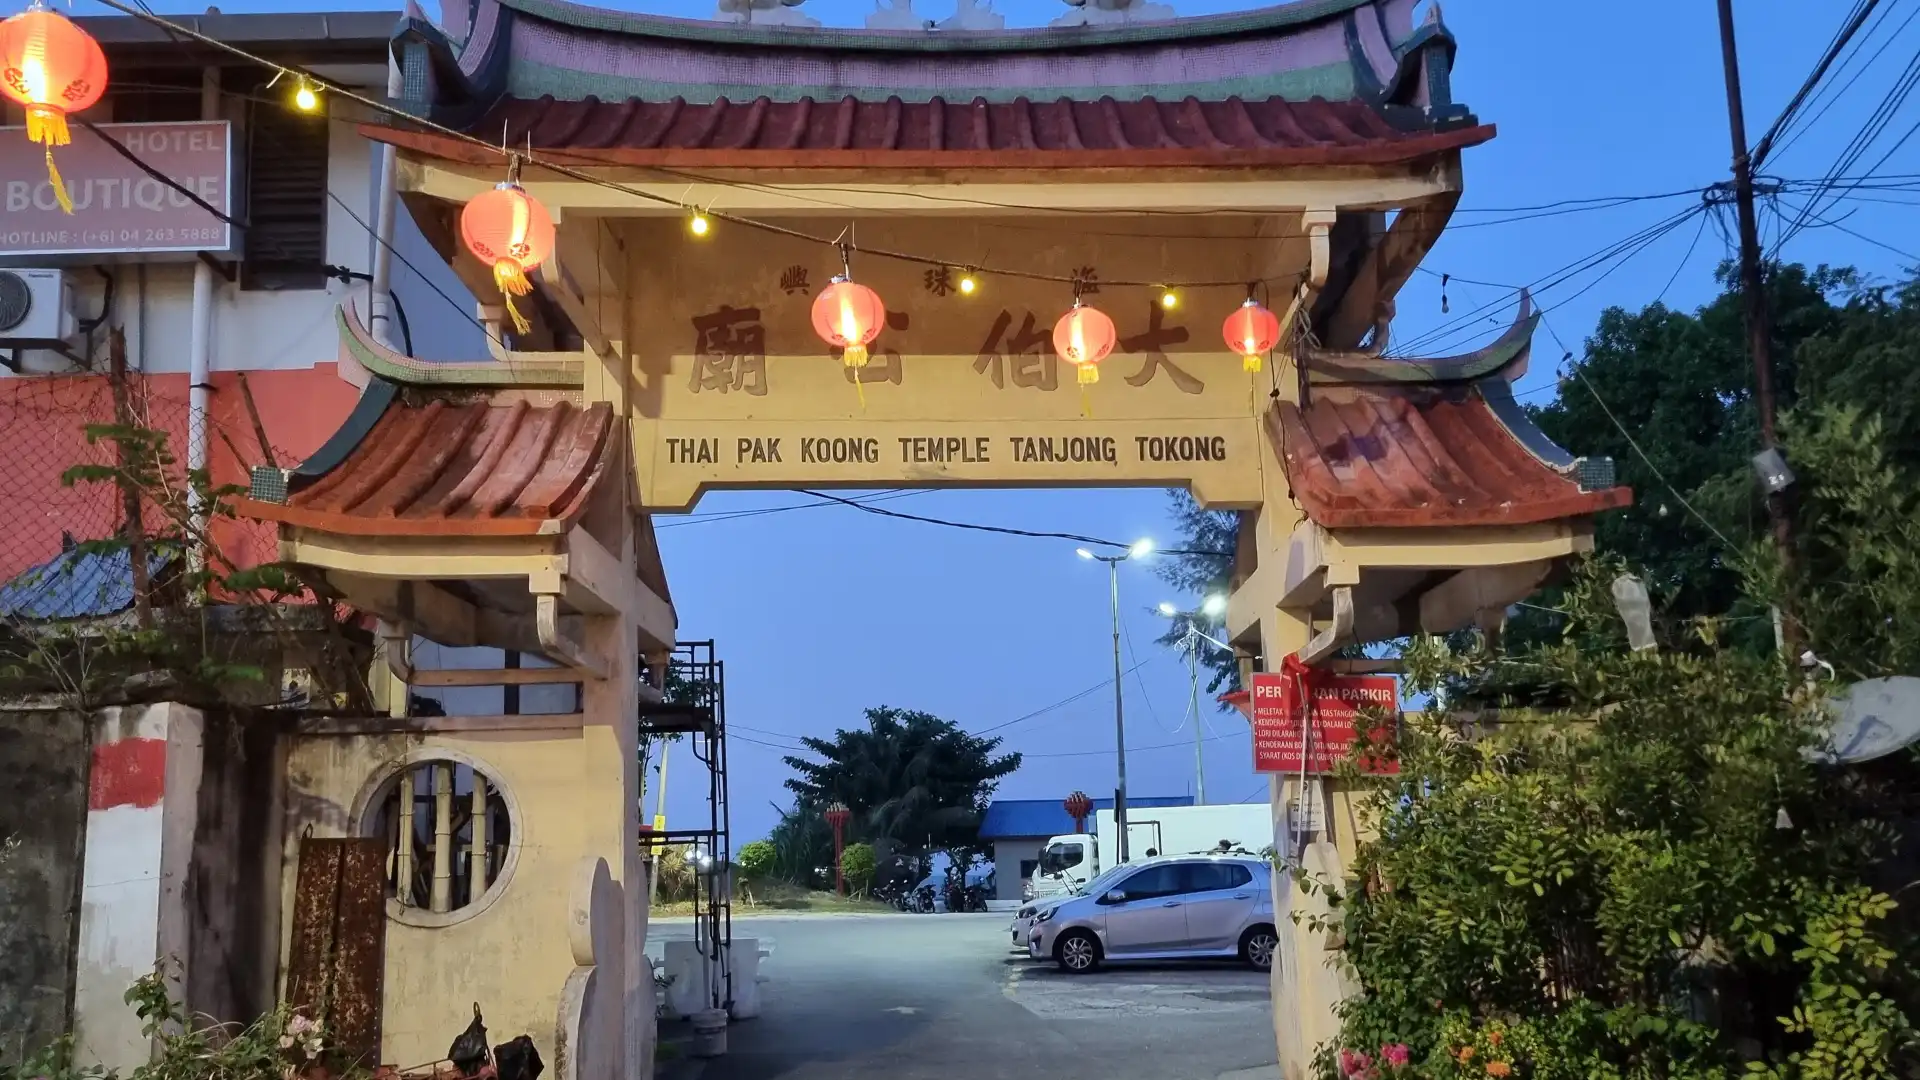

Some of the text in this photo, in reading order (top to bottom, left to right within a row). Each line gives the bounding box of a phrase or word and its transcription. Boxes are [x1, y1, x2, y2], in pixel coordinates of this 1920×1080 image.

[127, 130, 221, 154] HOTEL
[6, 174, 219, 212] BOUTIQUE
[121, 229, 139, 241] 04
[145, 228, 176, 241] 263
[180, 227, 219, 240] 5888
[665, 436, 1226, 463] THAI PAK KOONG TEMPLE TANJONG TOKONG
[1342, 688, 1391, 701] PARKIR
